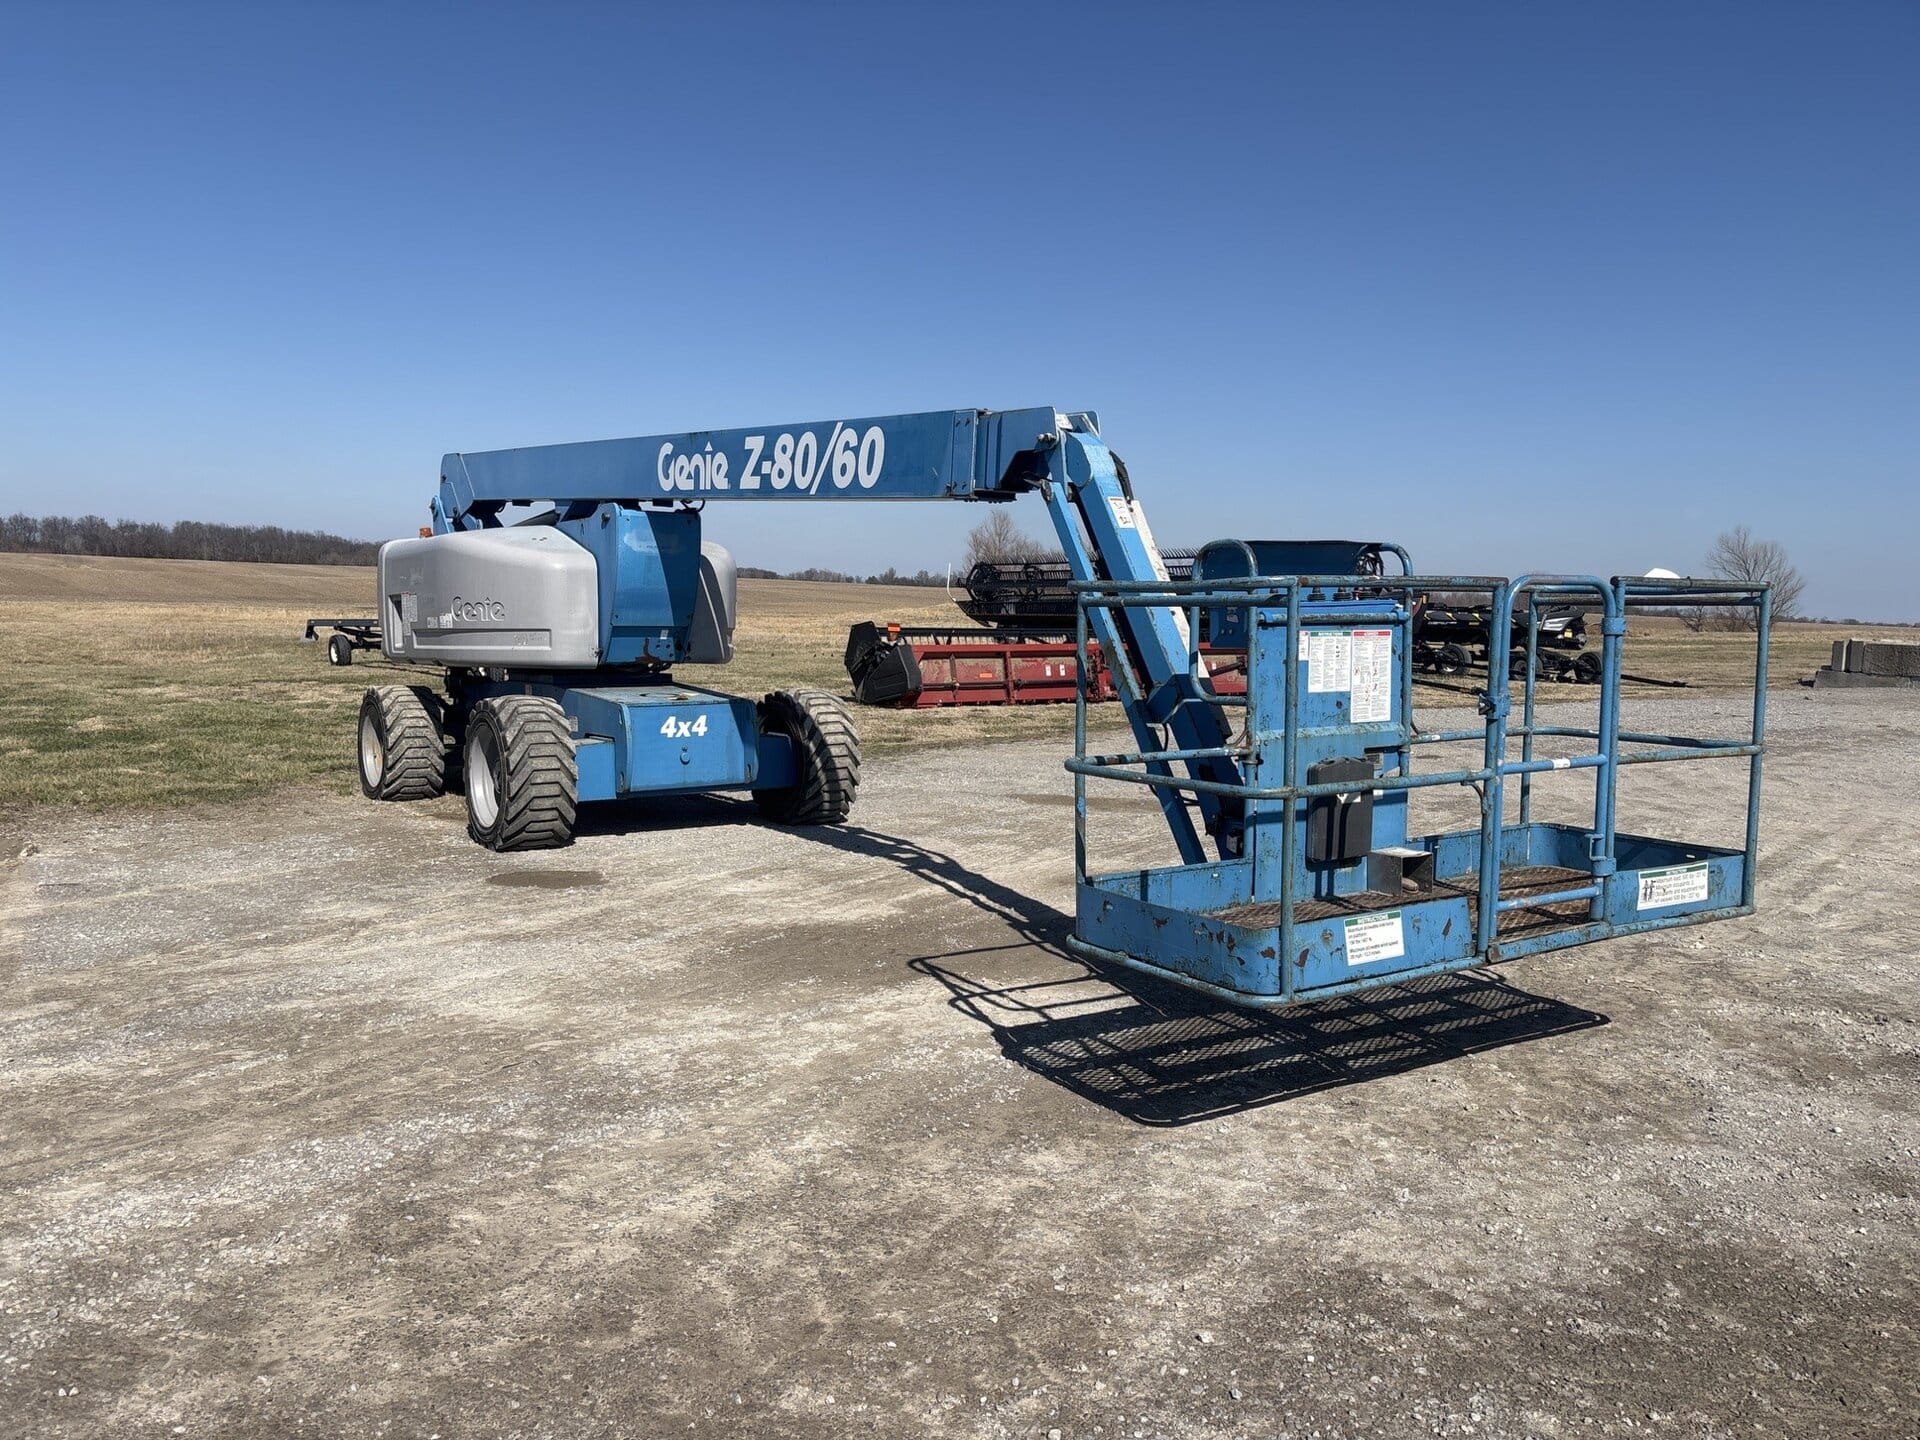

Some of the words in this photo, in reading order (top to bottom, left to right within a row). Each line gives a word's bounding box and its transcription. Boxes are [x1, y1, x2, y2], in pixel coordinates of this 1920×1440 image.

[657, 441, 729, 491] Genie
[739, 421, 886, 495] Z-80/60
[451, 596, 505, 622] Genie
[660, 714, 708, 738] 4x4
